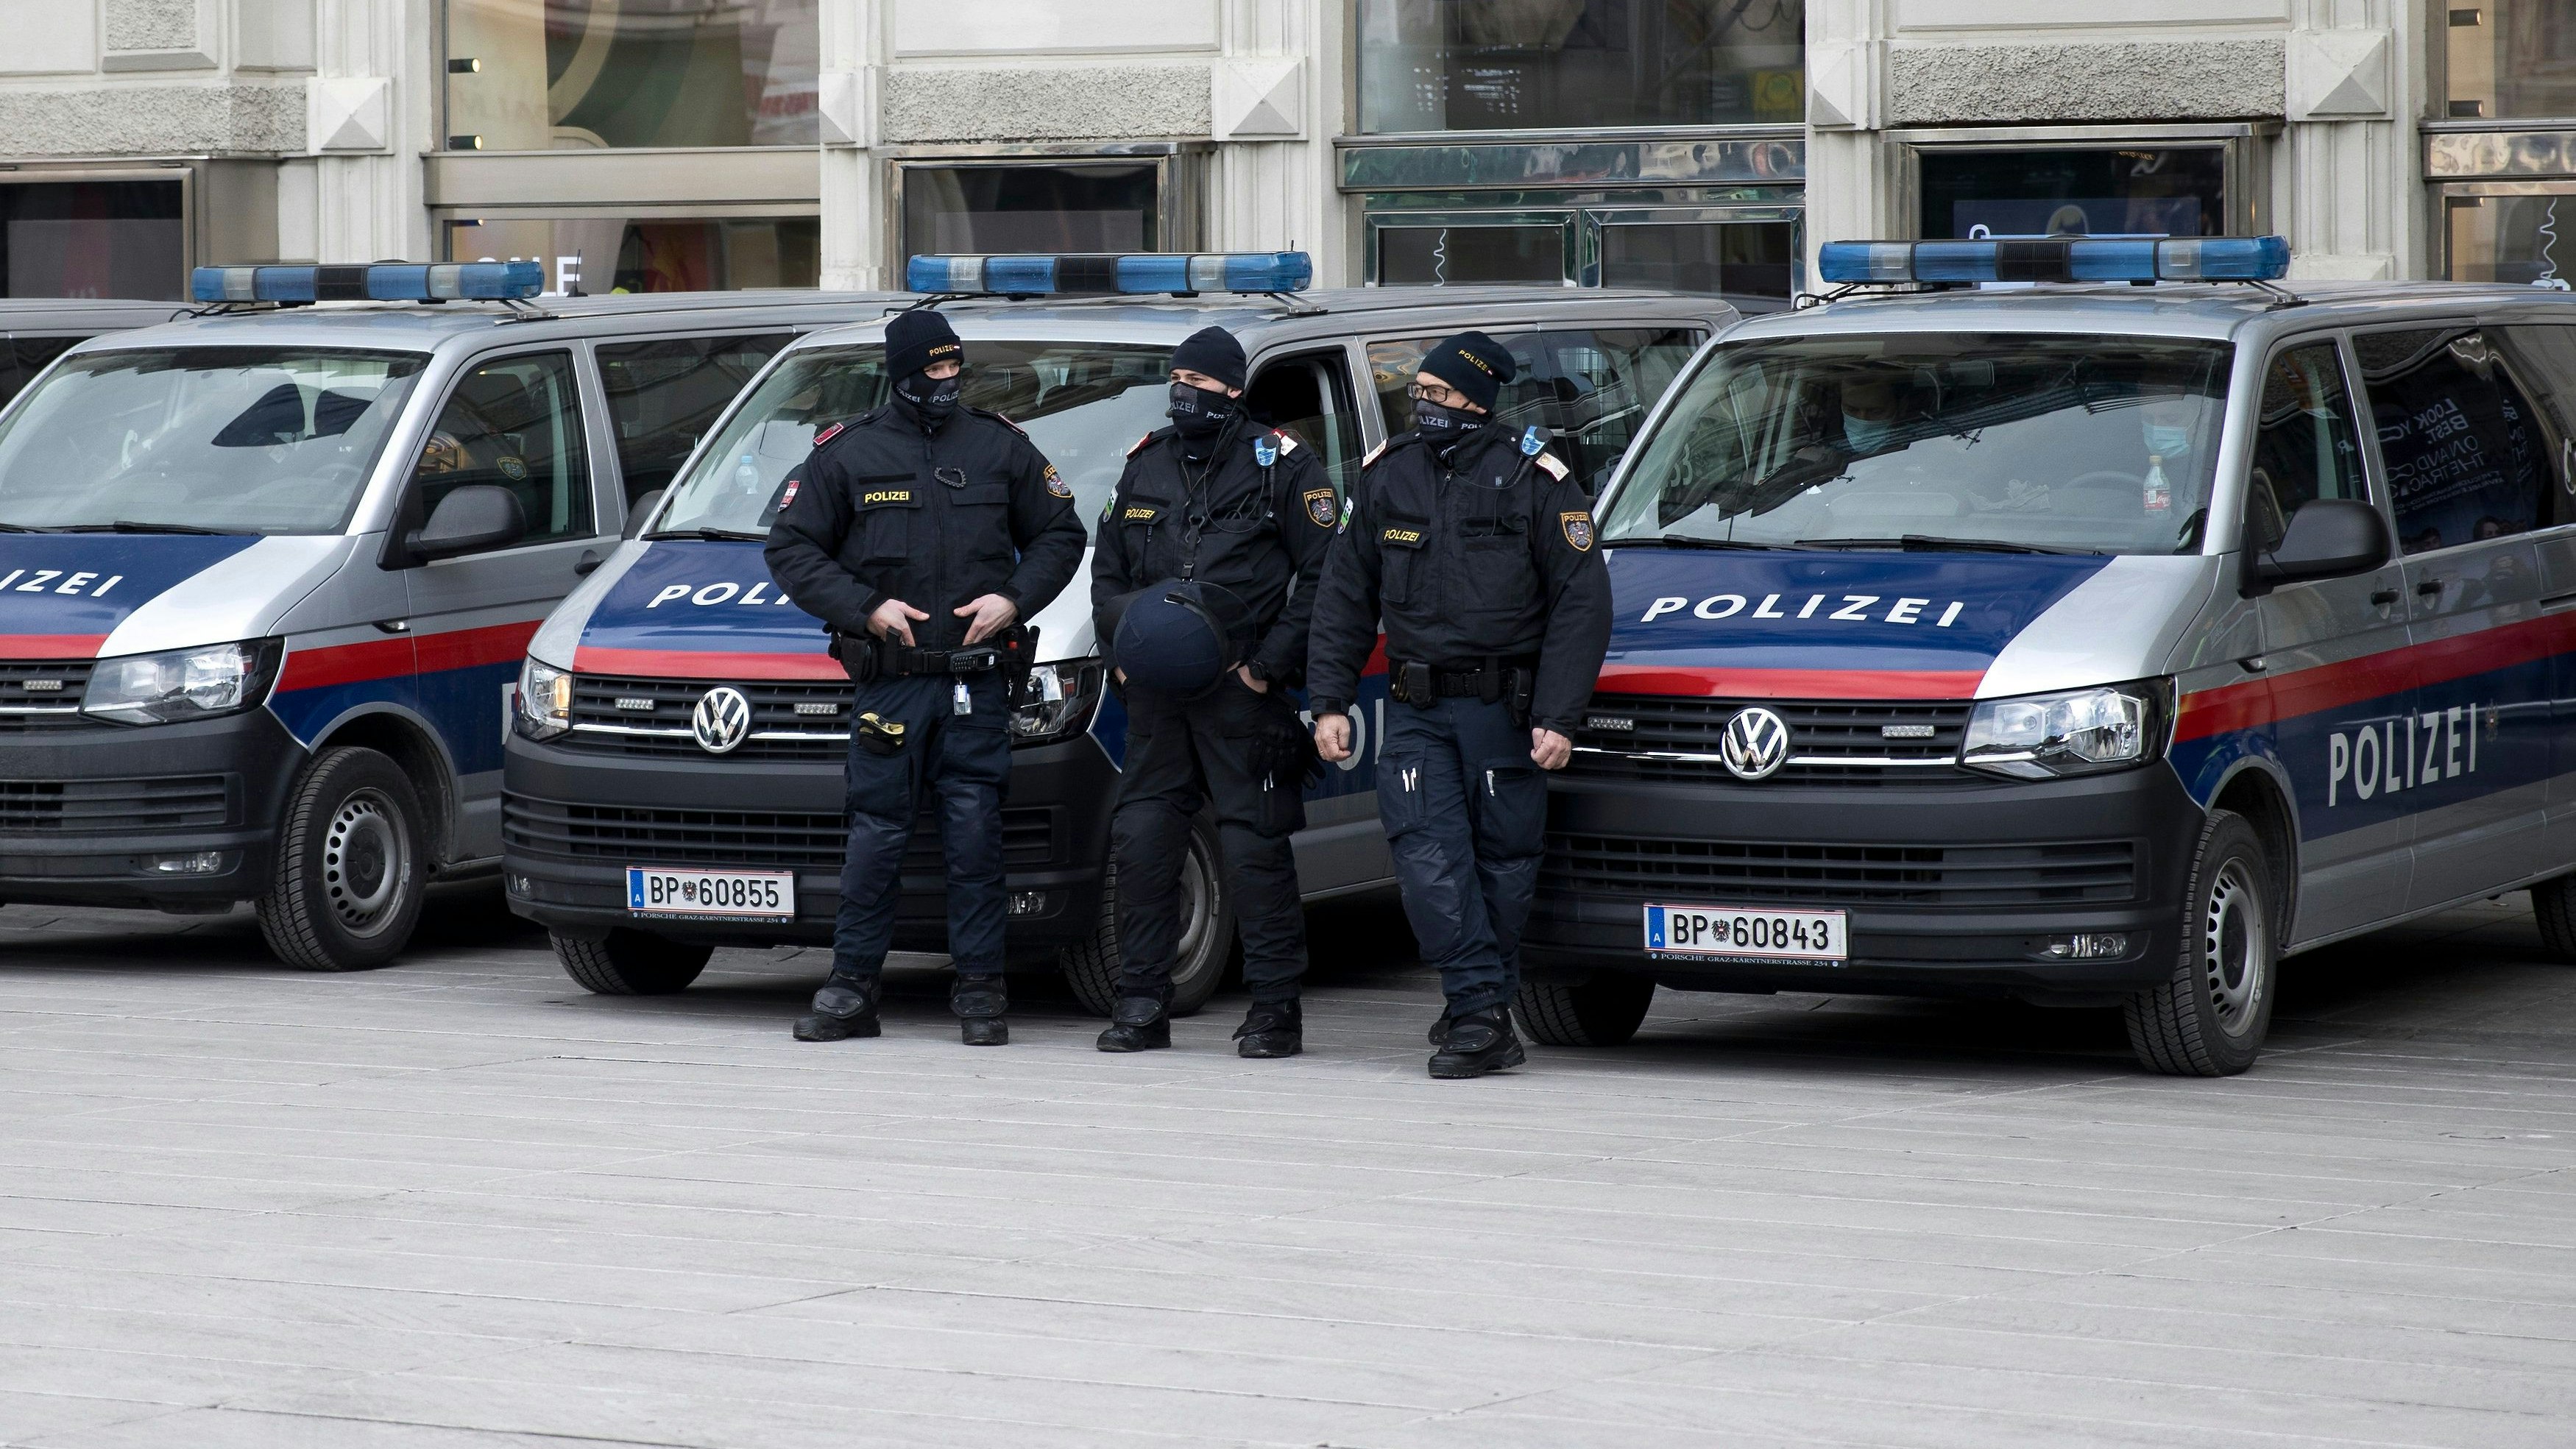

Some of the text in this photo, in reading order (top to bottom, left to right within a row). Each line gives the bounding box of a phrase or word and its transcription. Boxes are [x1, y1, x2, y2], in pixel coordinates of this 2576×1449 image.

[1418, 414, 1449, 428] LIZEI
[865, 491, 909, 503] POLIZEI
[1125, 509, 1155, 520] POLIZEI
[1384, 529, 1420, 542] POLIZEI
[1641, 594, 1964, 627] POLIZEI
[2329, 702, 2477, 807] POLIZEI
[634, 893, 641, 903] A
[651, 876, 779, 908] BP 60855
[641, 912, 676, 920] PORSCHE
[1653, 932, 1661, 943] A
[1673, 914, 1829, 950] BP 60843
[1661, 953, 1705, 962] PORSCHE
